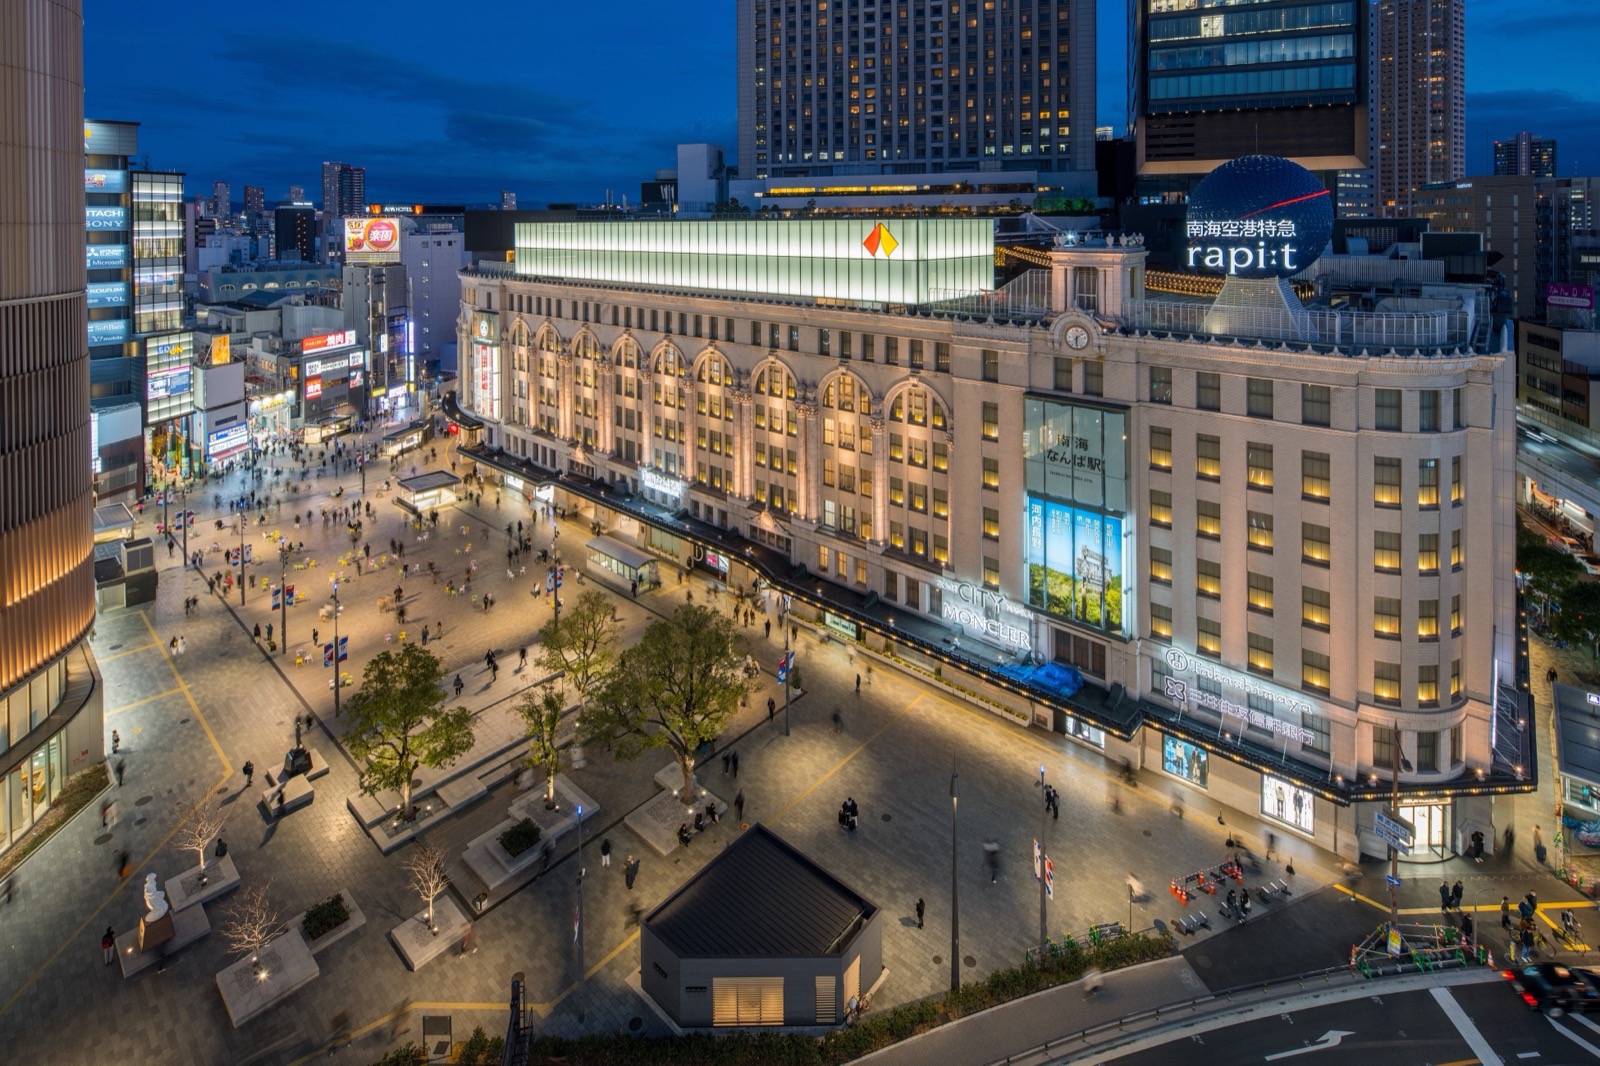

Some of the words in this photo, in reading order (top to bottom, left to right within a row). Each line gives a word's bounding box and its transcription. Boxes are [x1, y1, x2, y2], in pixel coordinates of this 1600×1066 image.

[369, 229, 393, 242] 楽園
[1186, 220, 1296, 238] 南海空港特急
[95, 323, 125, 331] SoftBank
[1058, 434, 1089, 452] 南海
[1047, 449, 1101, 472] なんば駅
[958, 581, 1005, 614] CITY
[943, 602, 1032, 650] MONCLER
[1189, 658, 1313, 715] Takashimaya
[1189, 688, 1315, 747] 三井住友信託銀行
